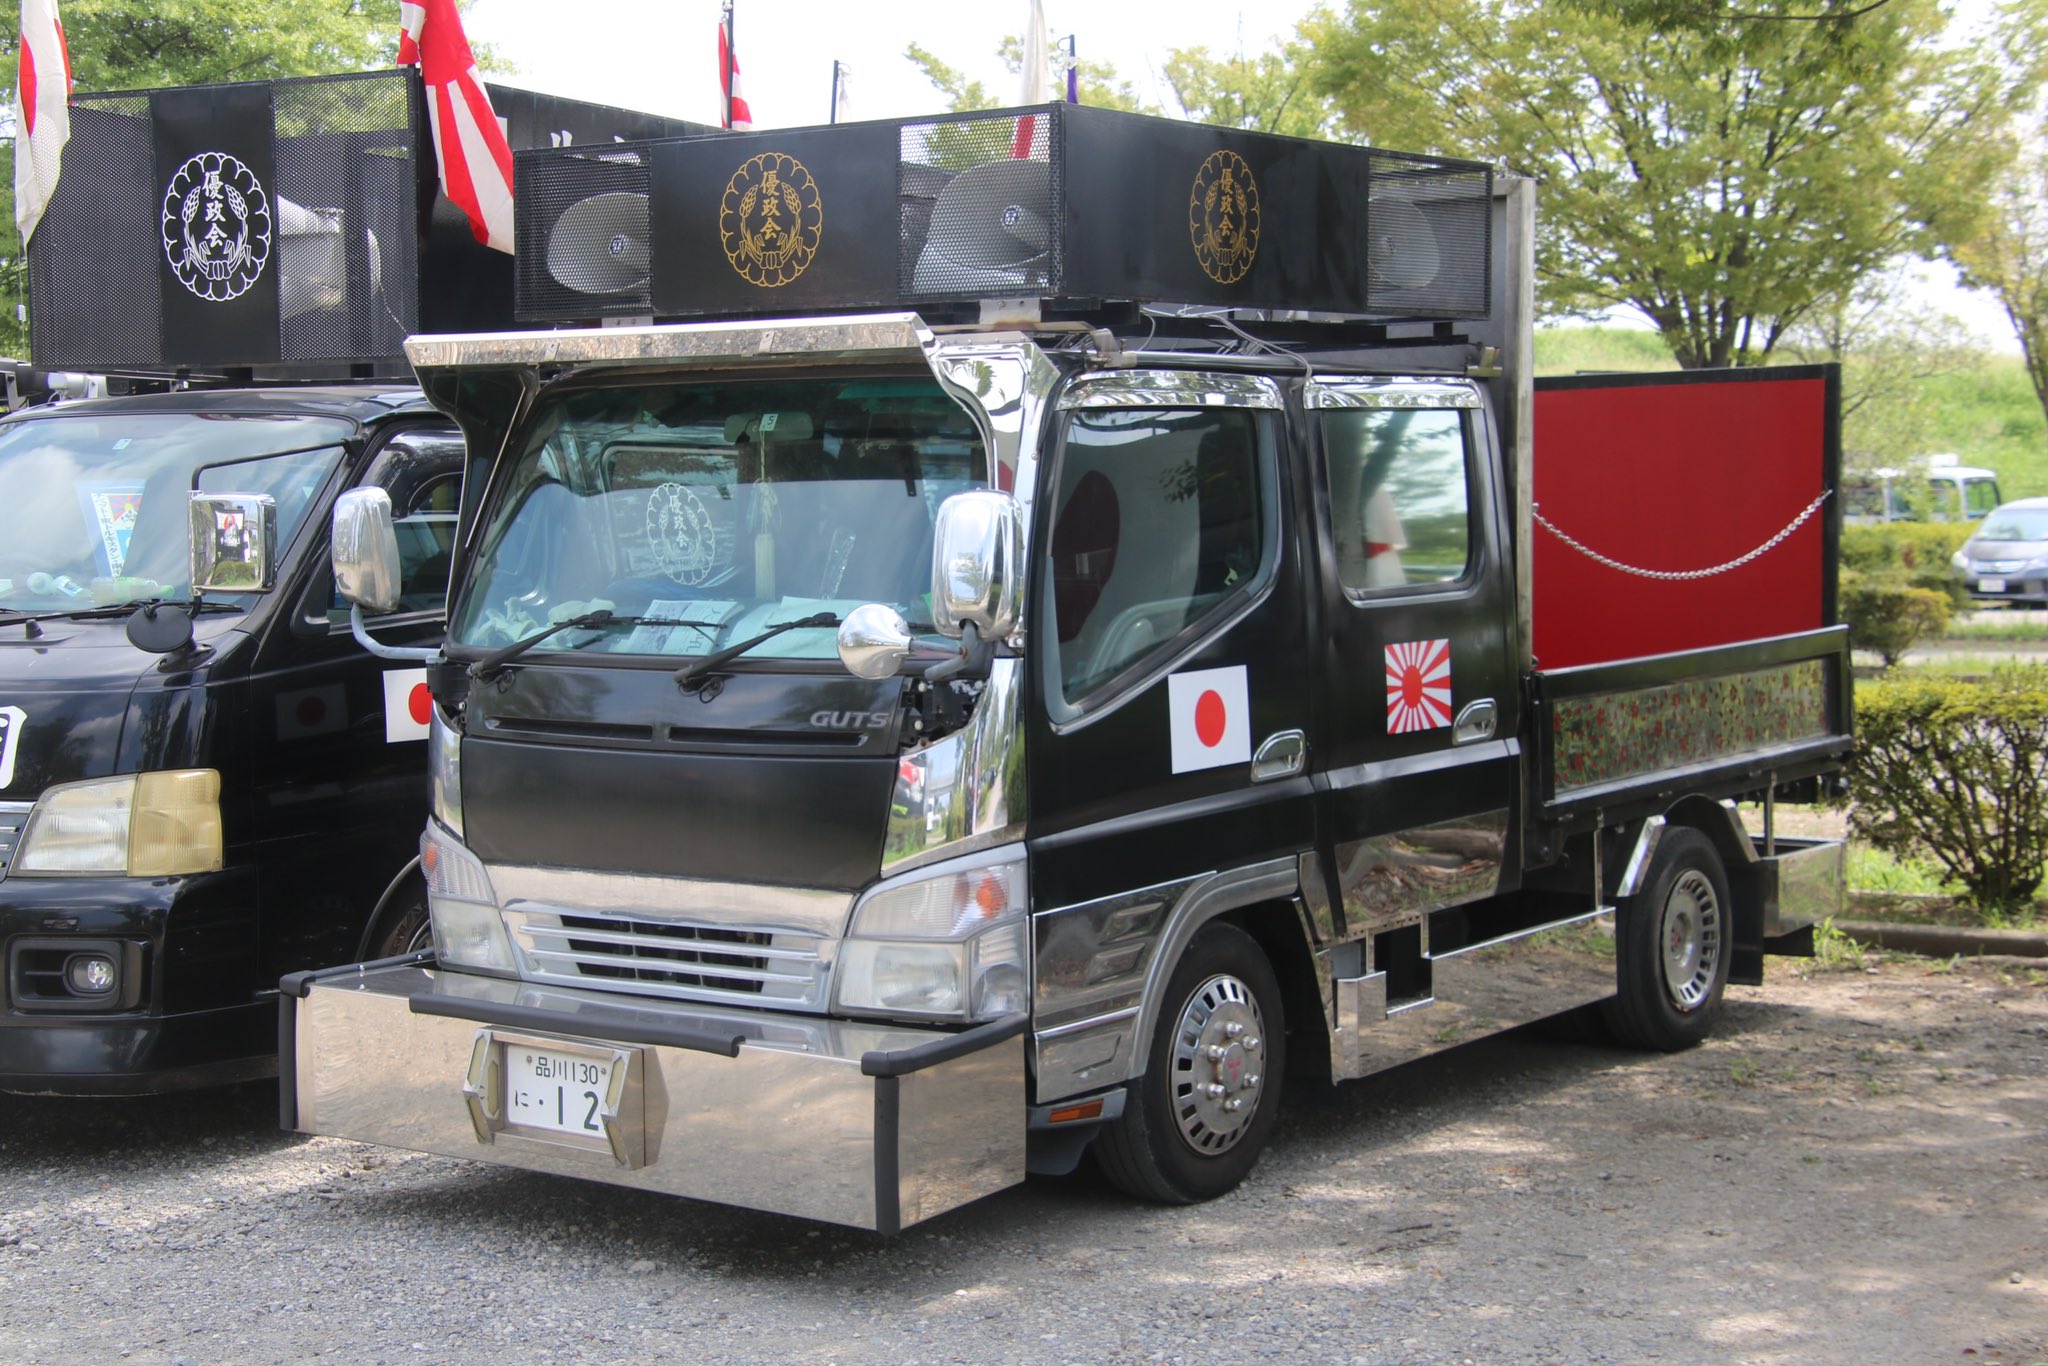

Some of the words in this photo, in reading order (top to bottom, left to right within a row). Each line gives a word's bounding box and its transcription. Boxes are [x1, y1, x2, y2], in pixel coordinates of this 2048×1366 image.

[202, 170, 228, 248] 優政会
[759, 169, 782, 241] 優政会
[1218, 168, 1234, 237] 優政会
[810, 710, 890, 728] GUTS
